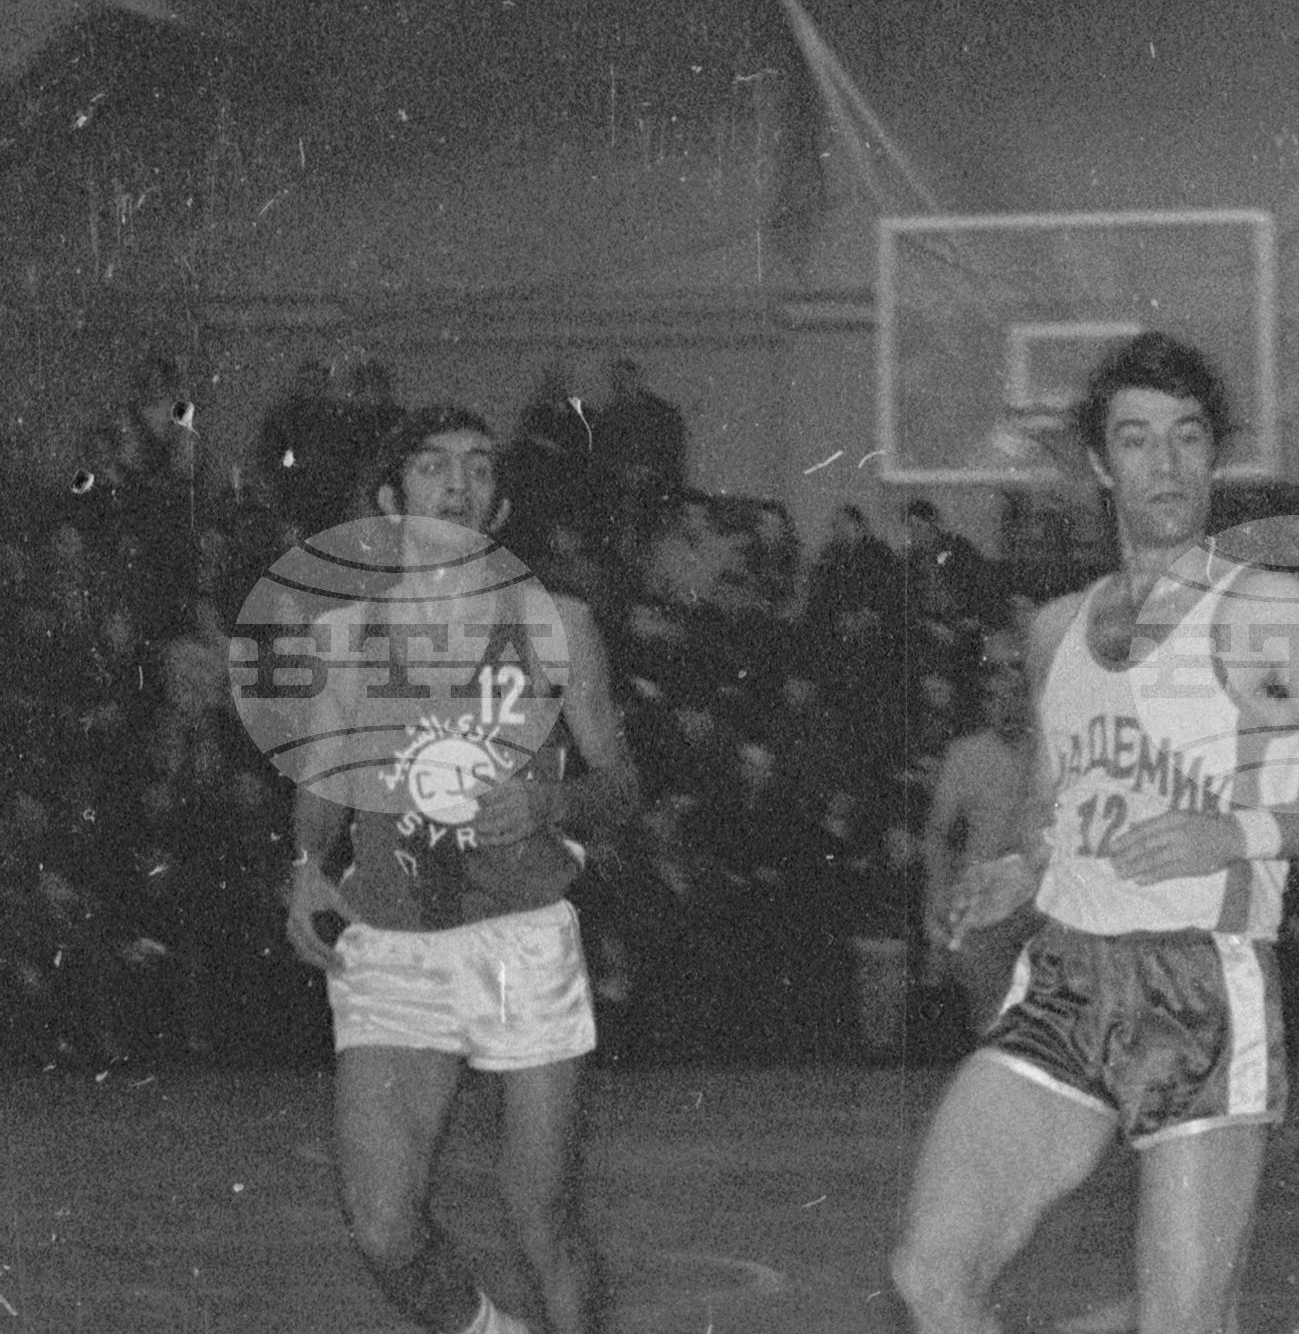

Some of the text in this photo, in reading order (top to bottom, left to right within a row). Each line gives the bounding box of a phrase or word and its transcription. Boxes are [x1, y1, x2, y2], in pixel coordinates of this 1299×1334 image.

[479, 665, 526, 725] 12
[396, 810, 478, 851] SYR
[1076, 793, 1128, 858] 12
